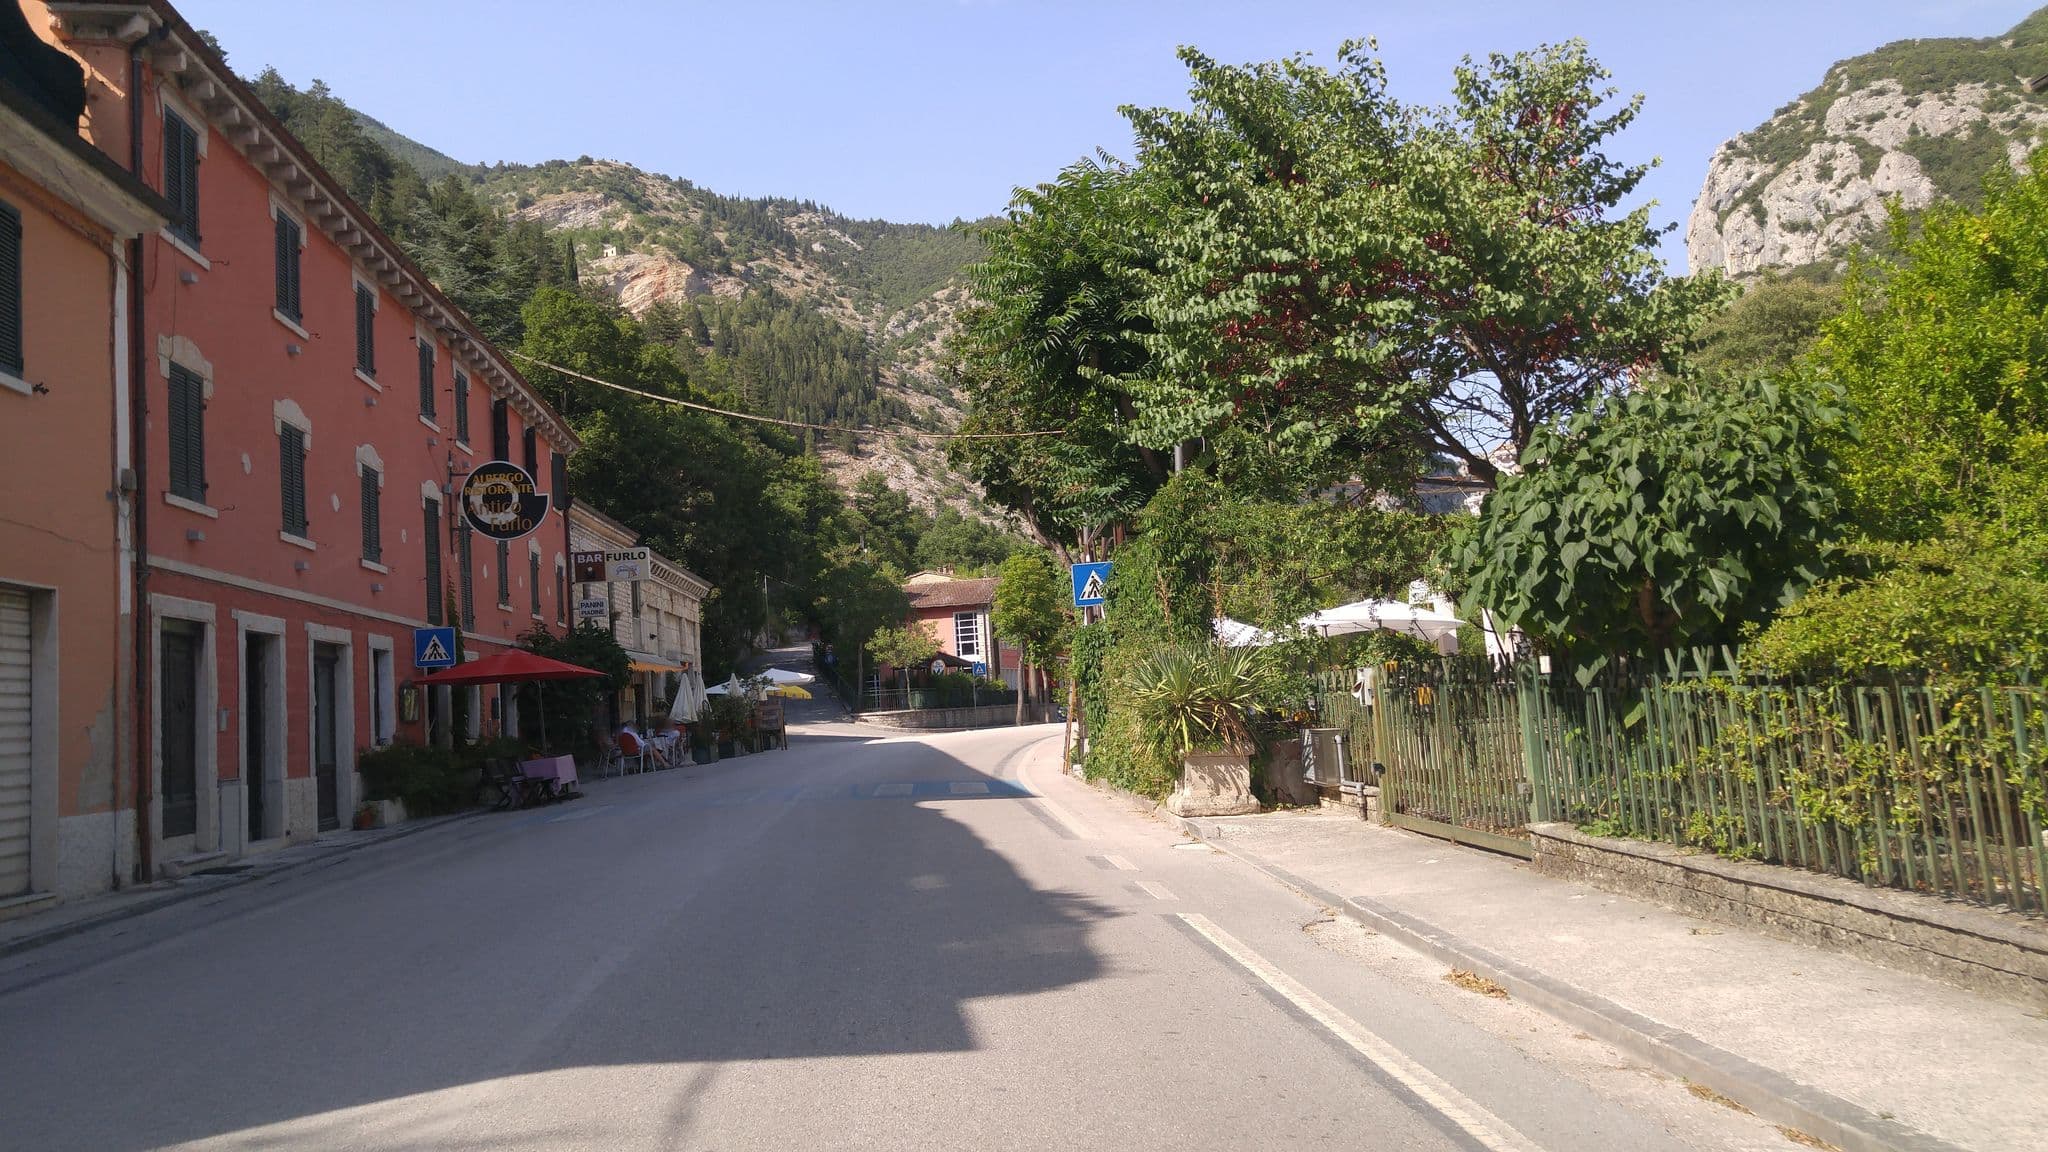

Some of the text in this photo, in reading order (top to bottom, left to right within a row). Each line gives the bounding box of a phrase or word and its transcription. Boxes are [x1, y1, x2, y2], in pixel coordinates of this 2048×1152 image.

[577, 551, 647, 564] BAR FURLO
[580, 601, 604, 609] PANINI
